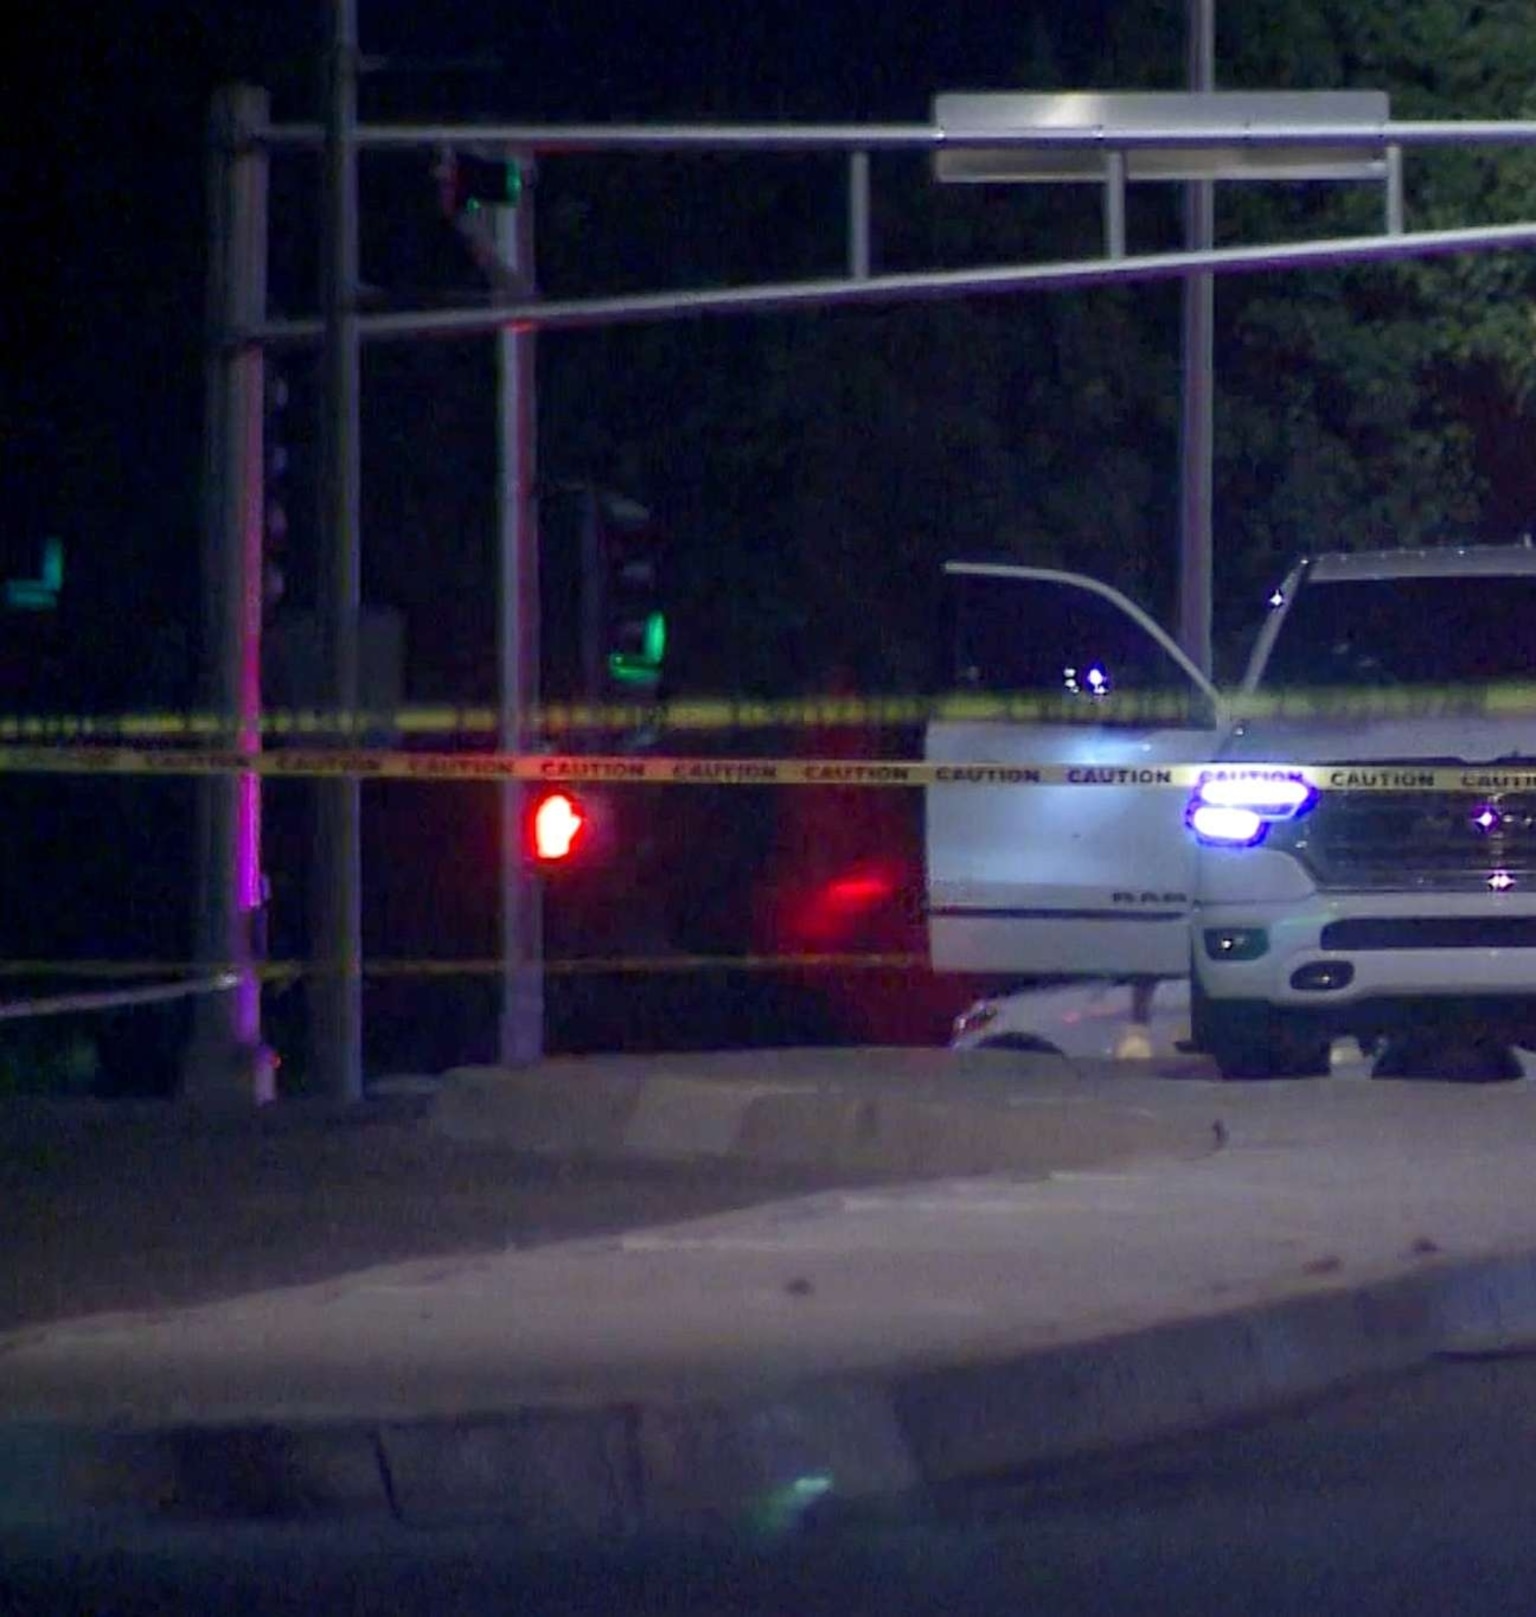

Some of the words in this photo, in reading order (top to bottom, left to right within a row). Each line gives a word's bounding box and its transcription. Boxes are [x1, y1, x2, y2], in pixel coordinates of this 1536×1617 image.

[541, 763, 646, 776] CAUTION
[804, 766, 909, 780] CAUTION
[935, 768, 1041, 783] CAUTION
[1067, 769, 1172, 784] CAUTION
[1330, 772, 1435, 787] CAUTION
